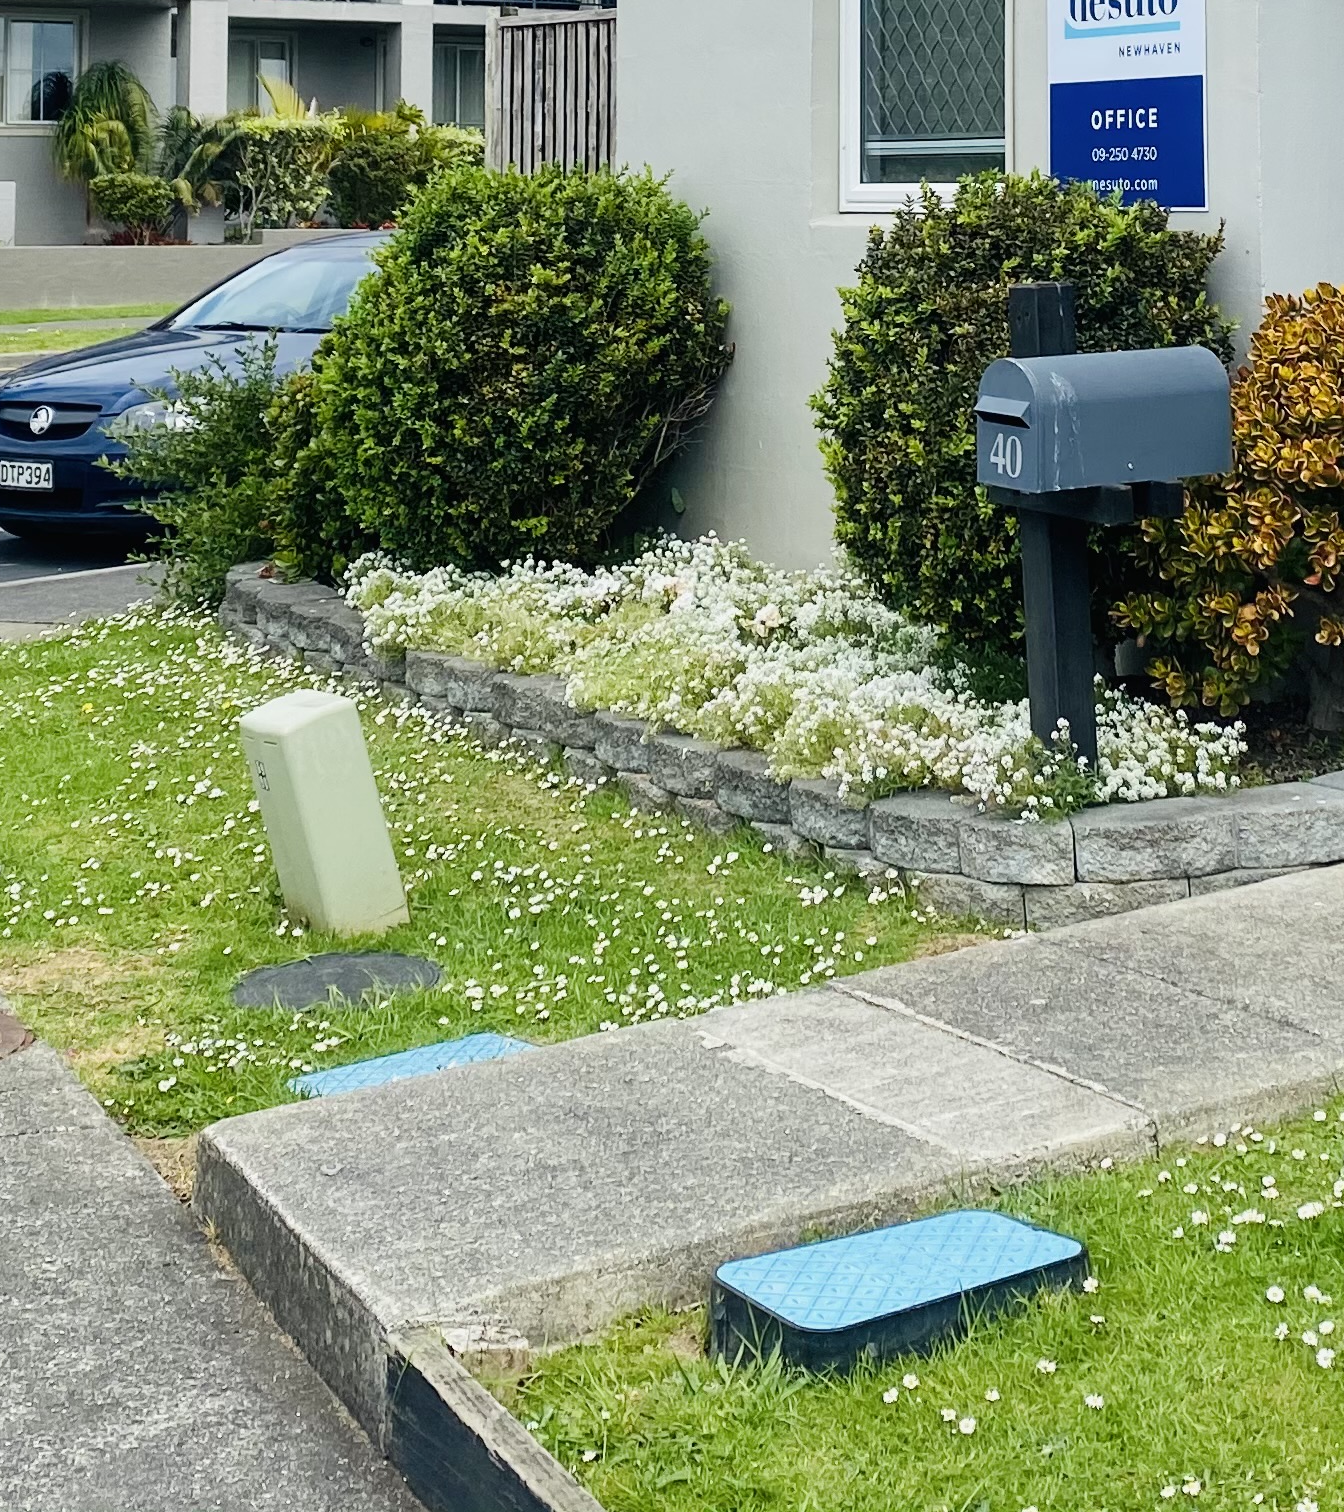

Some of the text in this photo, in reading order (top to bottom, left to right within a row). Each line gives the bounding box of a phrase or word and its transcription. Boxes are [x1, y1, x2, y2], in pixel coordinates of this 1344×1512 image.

[1119, 42, 1181, 58] NEWHAVEN
[1091, 107, 1158, 130] OFFICE
[1091, 146, 1158, 162] 09-250 4730
[1092, 178, 1158, 191] nesuto.com
[989, 433, 1023, 478] 40
[0, 464, 51, 486] DTP394
